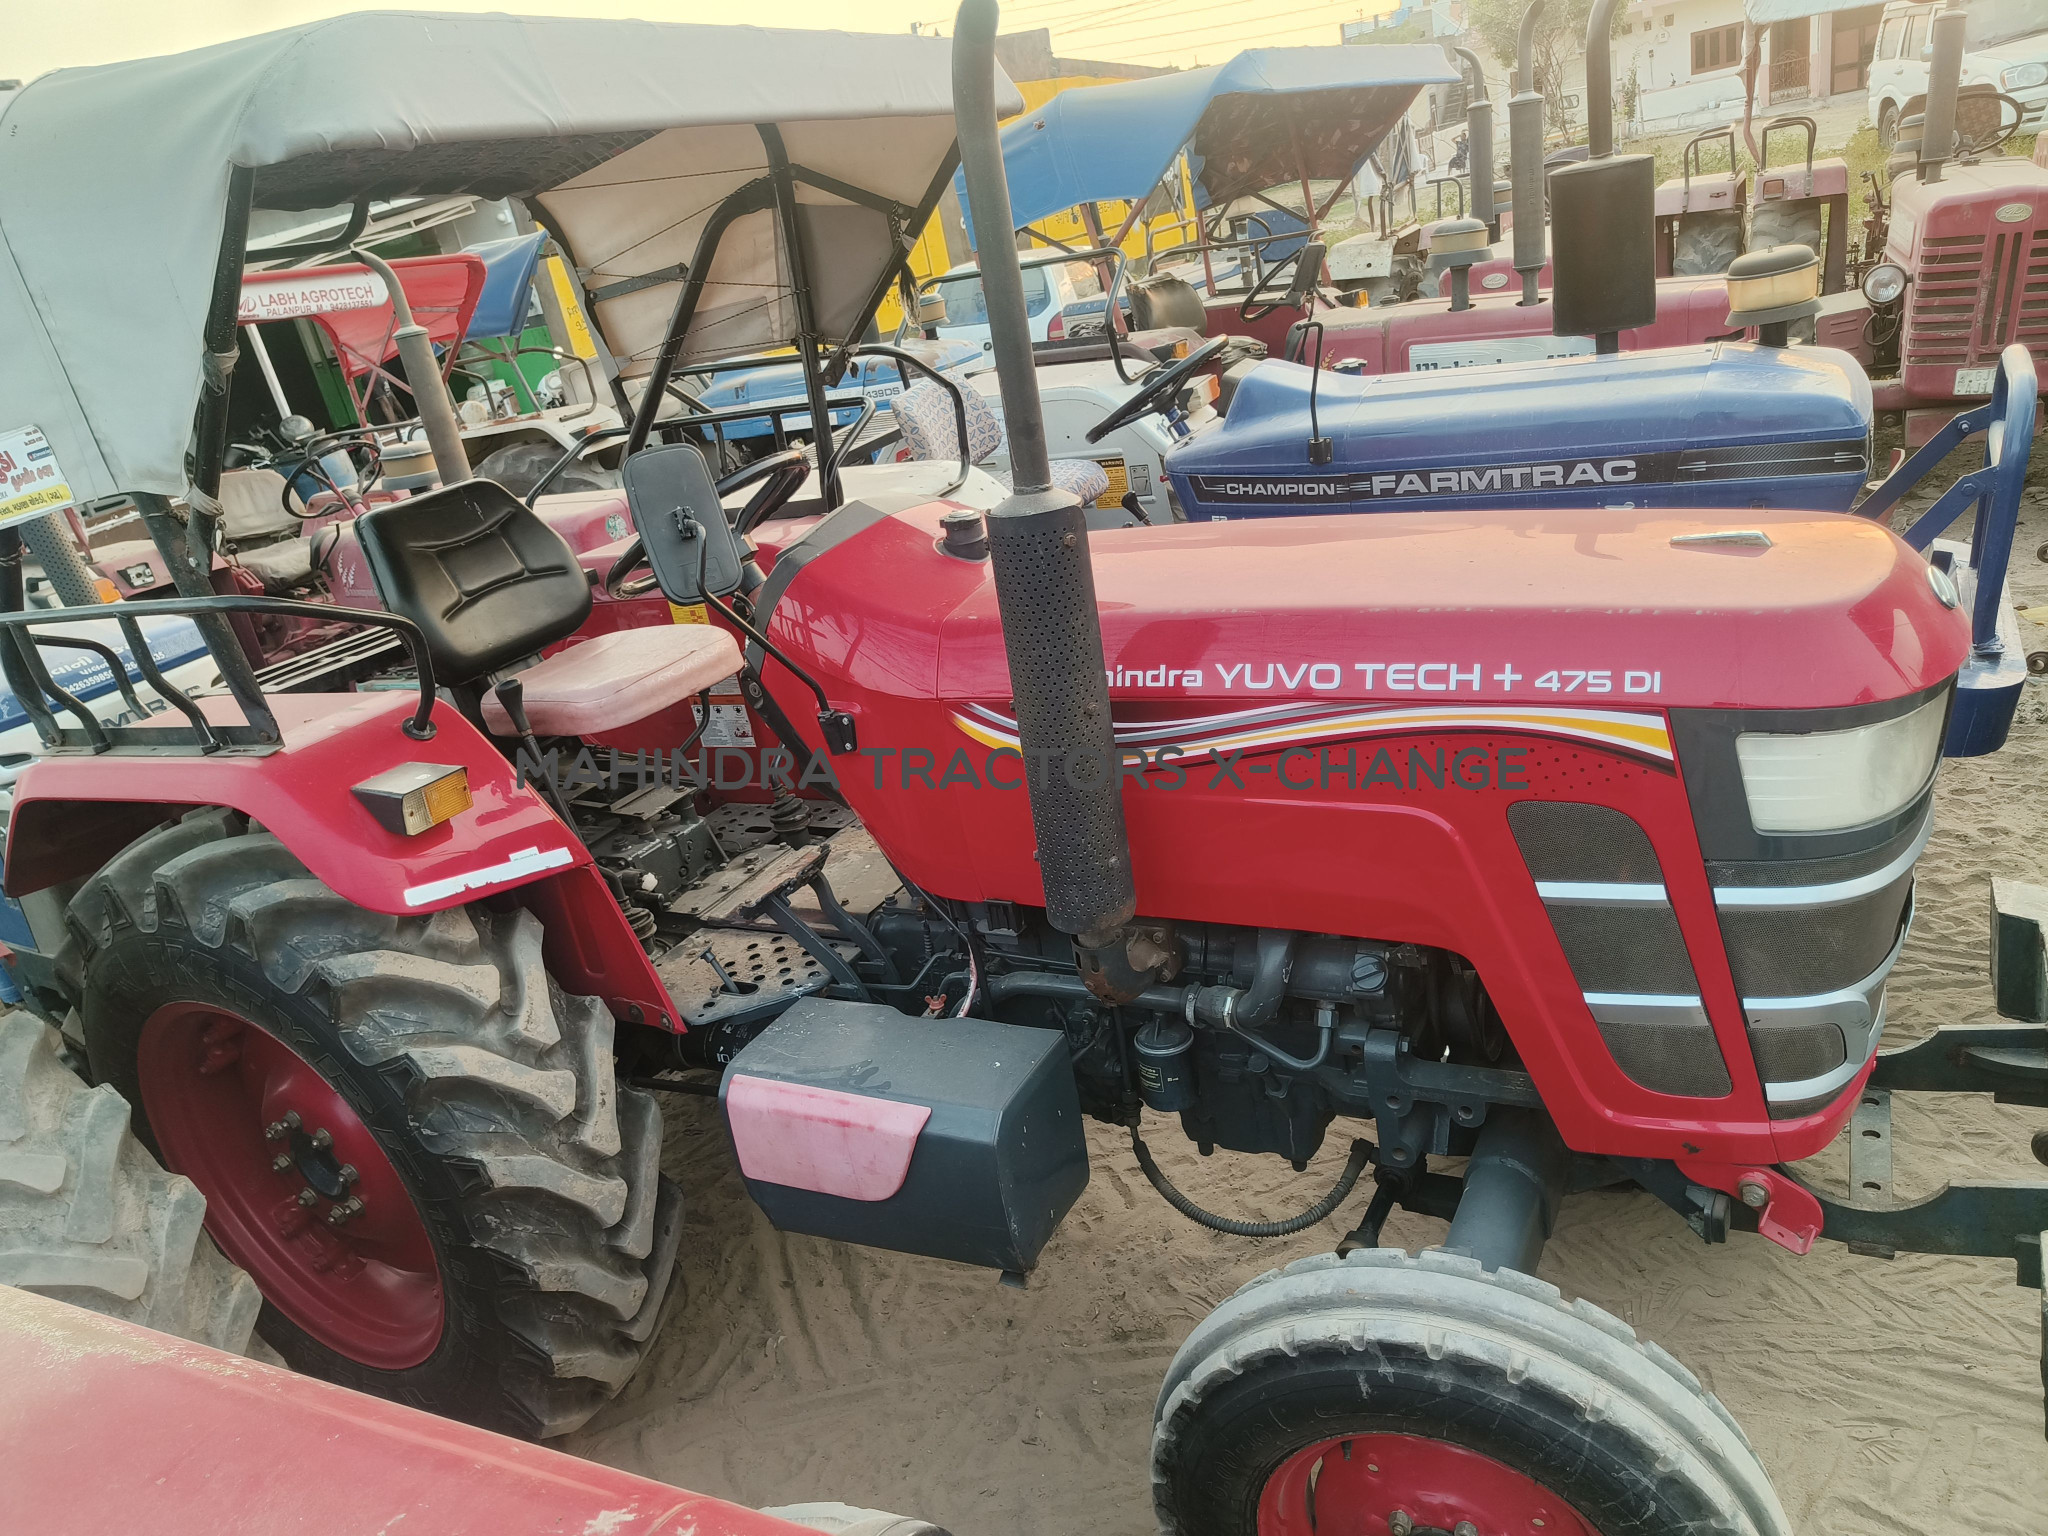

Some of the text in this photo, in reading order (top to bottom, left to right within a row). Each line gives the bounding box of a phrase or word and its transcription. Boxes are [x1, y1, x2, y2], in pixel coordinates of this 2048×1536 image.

[258, 285, 375, 308] LABH AGROTECH
[1226, 459, 1638, 496] CHAMPION FARMTRAC
[1215, 663, 1342, 690] YUVO
[1354, 663, 1482, 691] TECH
[1493, 663, 1523, 691] +
[1534, 670, 1612, 693] 475
[1624, 671, 1661, 694] DI
